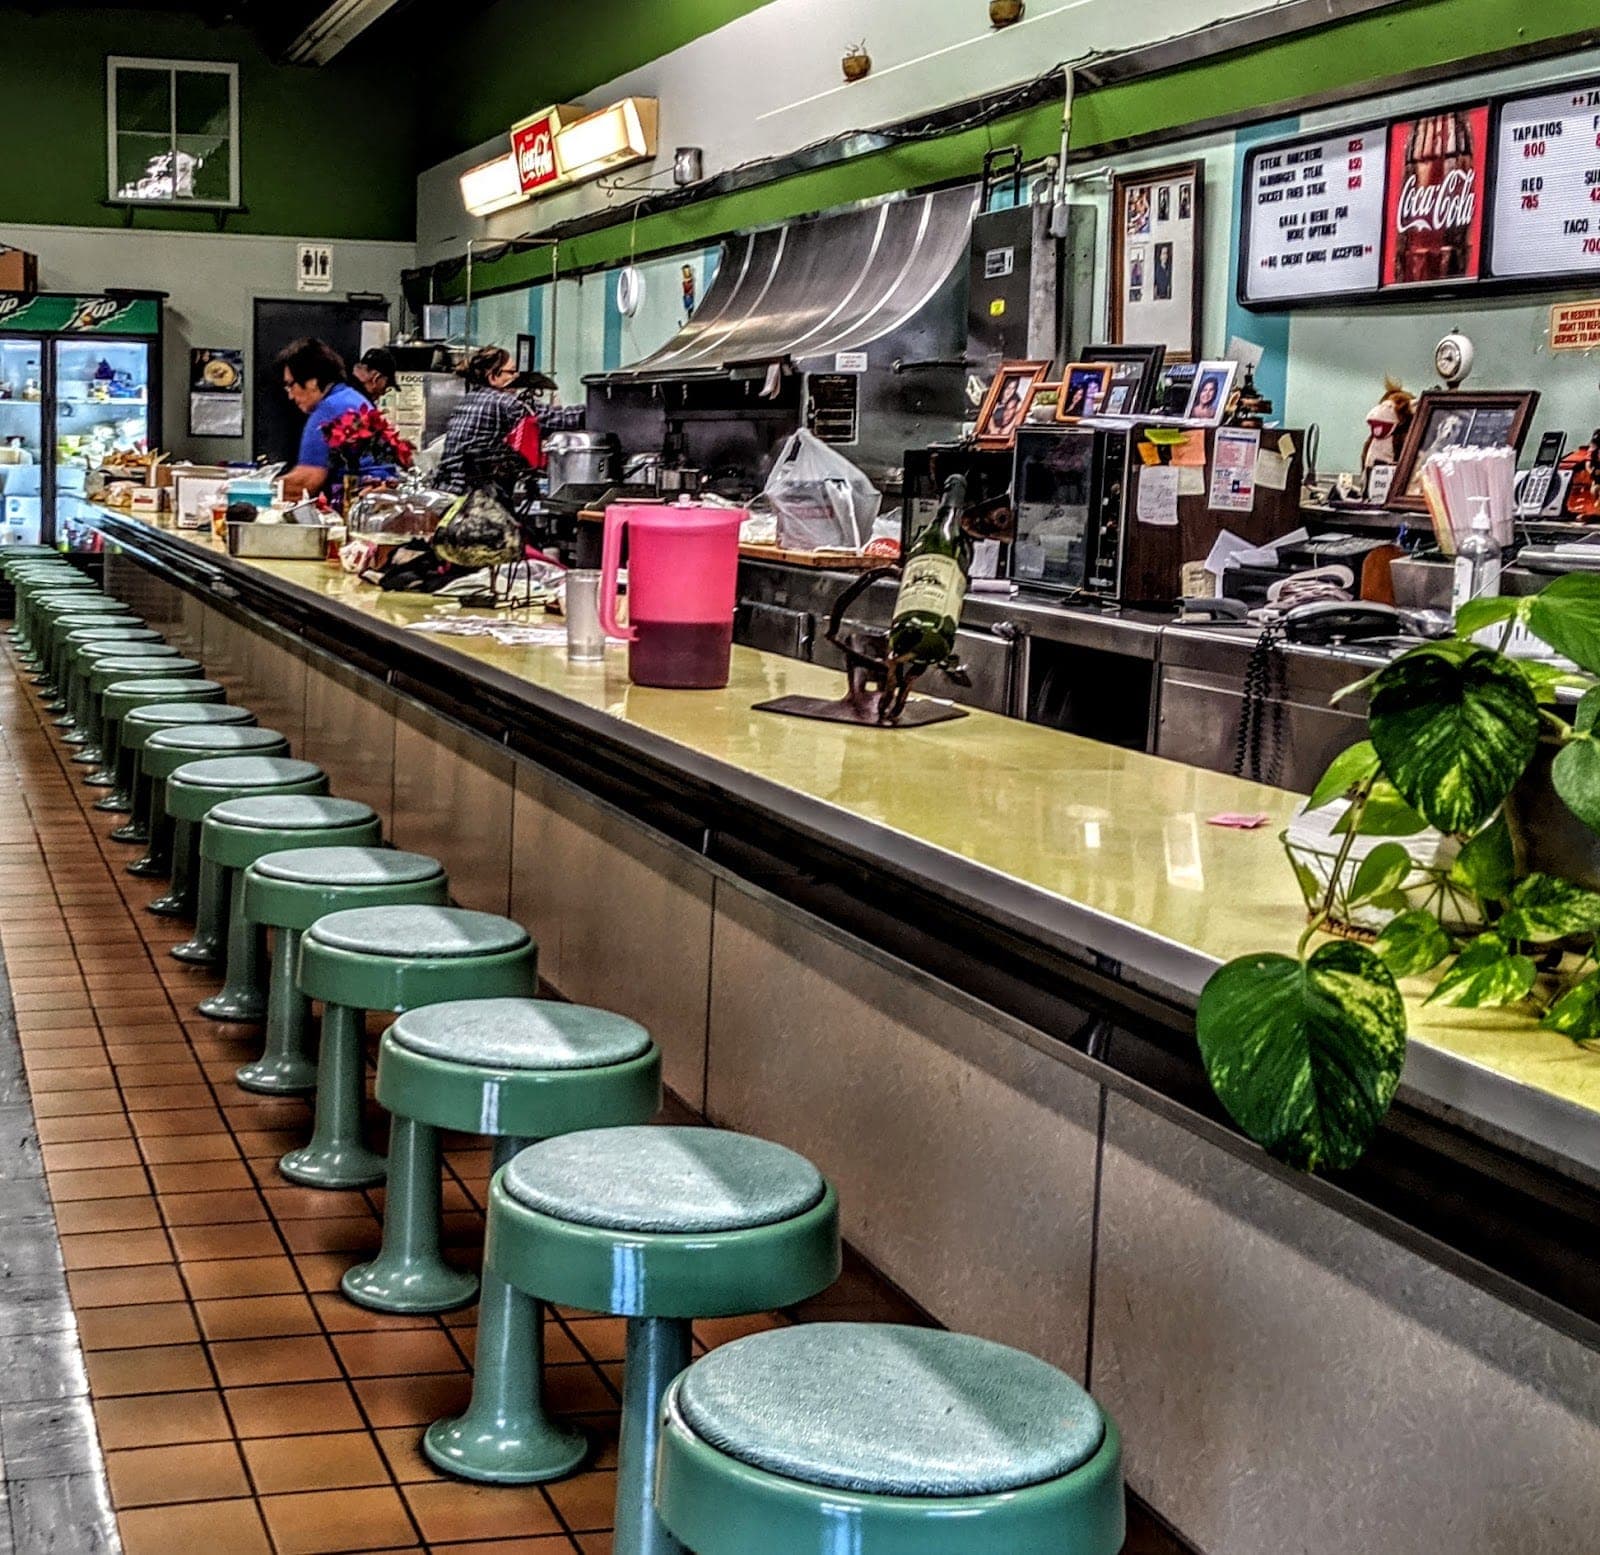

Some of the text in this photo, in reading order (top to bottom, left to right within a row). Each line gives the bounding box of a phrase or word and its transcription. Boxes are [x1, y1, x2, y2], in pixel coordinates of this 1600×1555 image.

[1512, 121, 1562, 141] TAPATIOS
[1524, 141, 1546, 157] 800
[1521, 176, 1543, 192] RED
[1397, 168, 1475, 233] Coca-Cola
[1308, 223, 1337, 238] OPTIONS
[1564, 218, 1589, 235] TACO
